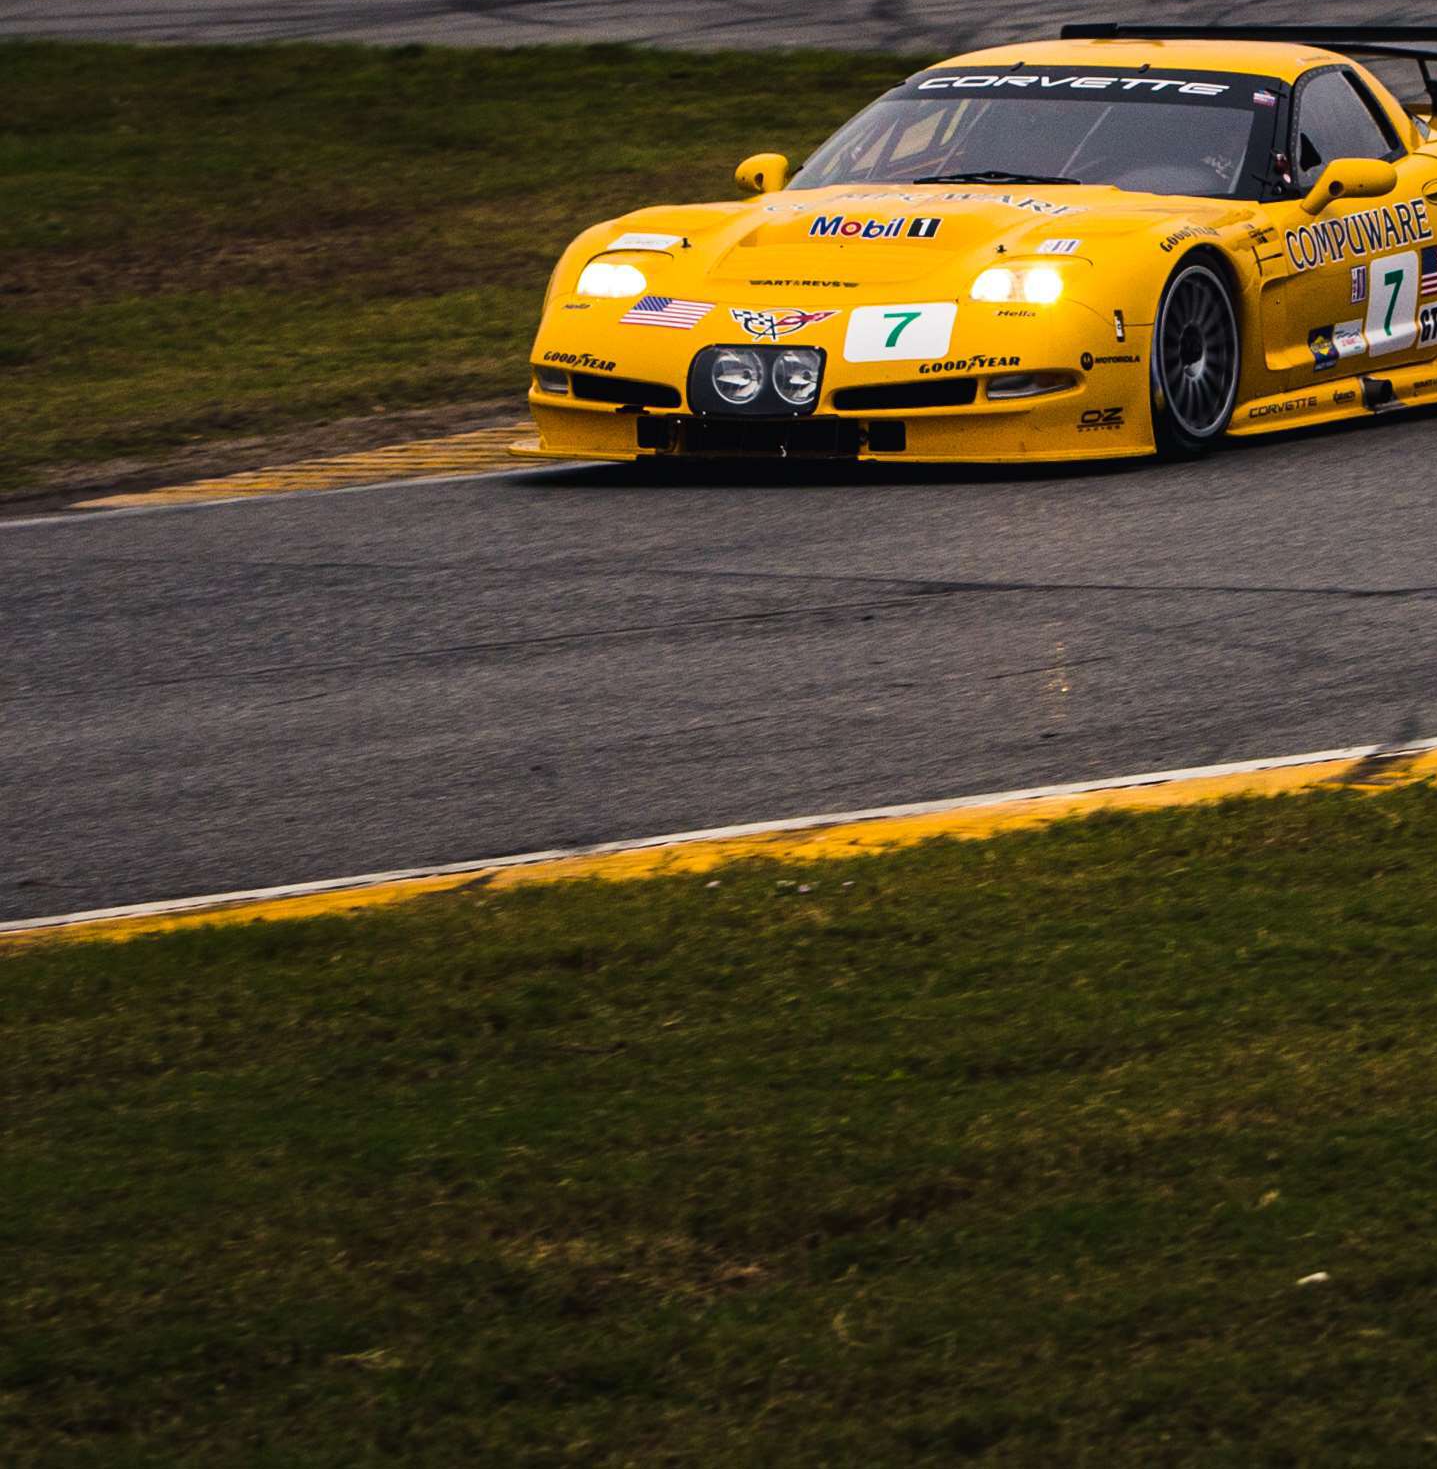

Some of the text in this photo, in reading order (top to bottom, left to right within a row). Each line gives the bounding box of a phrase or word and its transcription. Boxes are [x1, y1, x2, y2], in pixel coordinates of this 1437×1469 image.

[918, 75, 1230, 96] CORVETTE
[809, 216, 905, 239] Mobil
[1285, 198, 1433, 271] COMPUWARE
[1384, 268, 1404, 337] 7
[883, 311, 922, 348] 7
[918, 354, 1021, 374] GOODYEAR
[1081, 407, 1124, 424] OZ
[1248, 396, 1317, 418] CORVETTE
